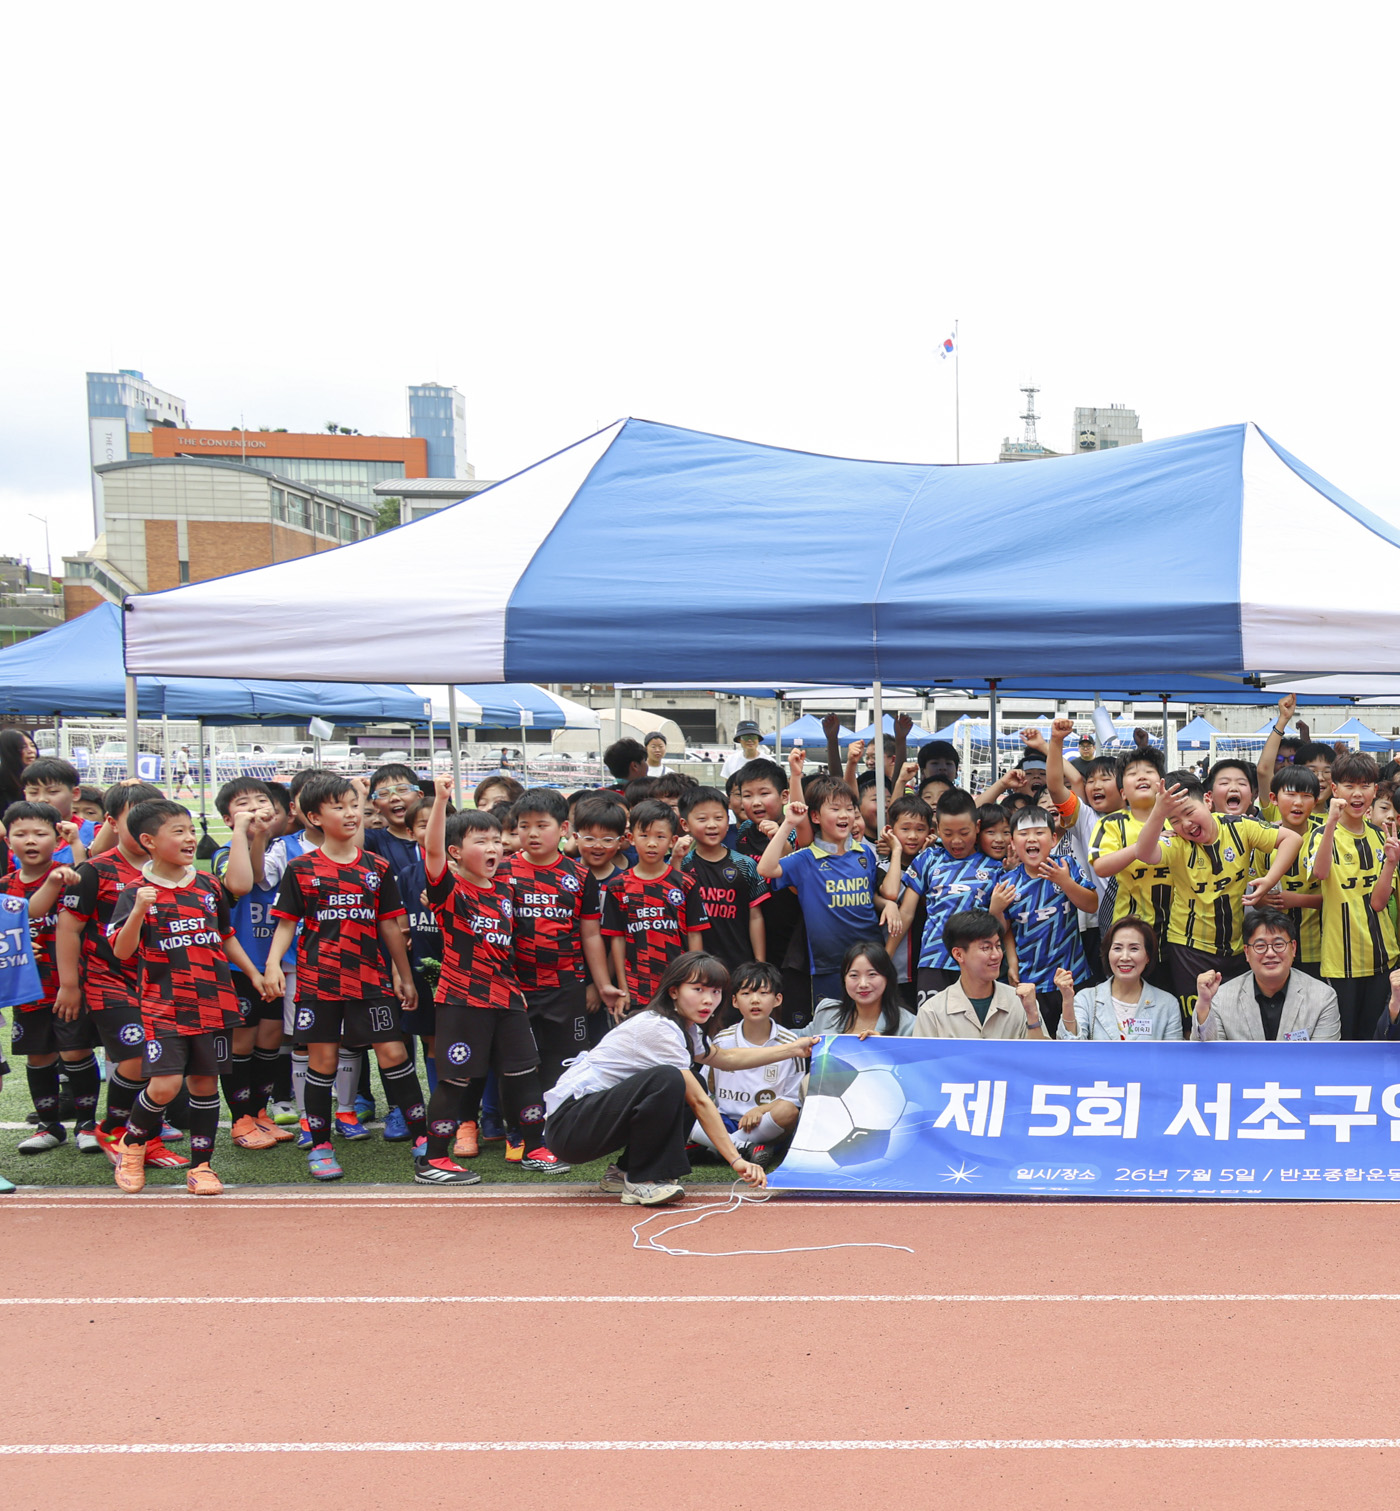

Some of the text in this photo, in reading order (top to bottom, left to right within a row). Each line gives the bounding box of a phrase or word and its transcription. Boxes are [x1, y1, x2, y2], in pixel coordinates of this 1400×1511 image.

[178, 437, 267, 448] THE CONVENTION
[1131, 867, 1170, 880] JP
[1191, 869, 1245, 893] JPI
[826, 876, 869, 893] BANPO
[1286, 881, 1320, 892] PI
[1341, 875, 1377, 889] JP
[329, 893, 363, 906] BEST
[523, 893, 559, 905] BEST
[699, 887, 736, 903] ANPO
[828, 893, 872, 908] JUNIOR
[931, 884, 986, 902] JPI
[250, 903, 276, 925] BE
[317, 908, 376, 921] KIDS GYM
[544, 907, 573, 918] GYM
[636, 907, 665, 919] BEST
[704, 903, 737, 918] NIOR
[1016, 901, 1071, 924] JPI
[168, 918, 206, 933] BEST
[416, 925, 439, 933] SPORTS
[626, 918, 678, 933] KIDS GYM
[0, 928, 23, 954] ST
[159, 932, 222, 951] KIDS GYM
[486, 932, 512, 946] GYM
[369, 1006, 394, 1032] 13
[574, 1016, 586, 1041] 5
[718, 1088, 751, 1103] BMO
[933, 1080, 1007, 1137] 제
[1027, 1080, 1141, 1139] 5회
[1016, 1168, 1096, 1180] 일시/장소
[1114, 1168, 1168, 1182] 26년
[1176, 1168, 1212, 1182] 7월
[1218, 1168, 1256, 1182] 5일
[1262, 1168, 1273, 1182] /
